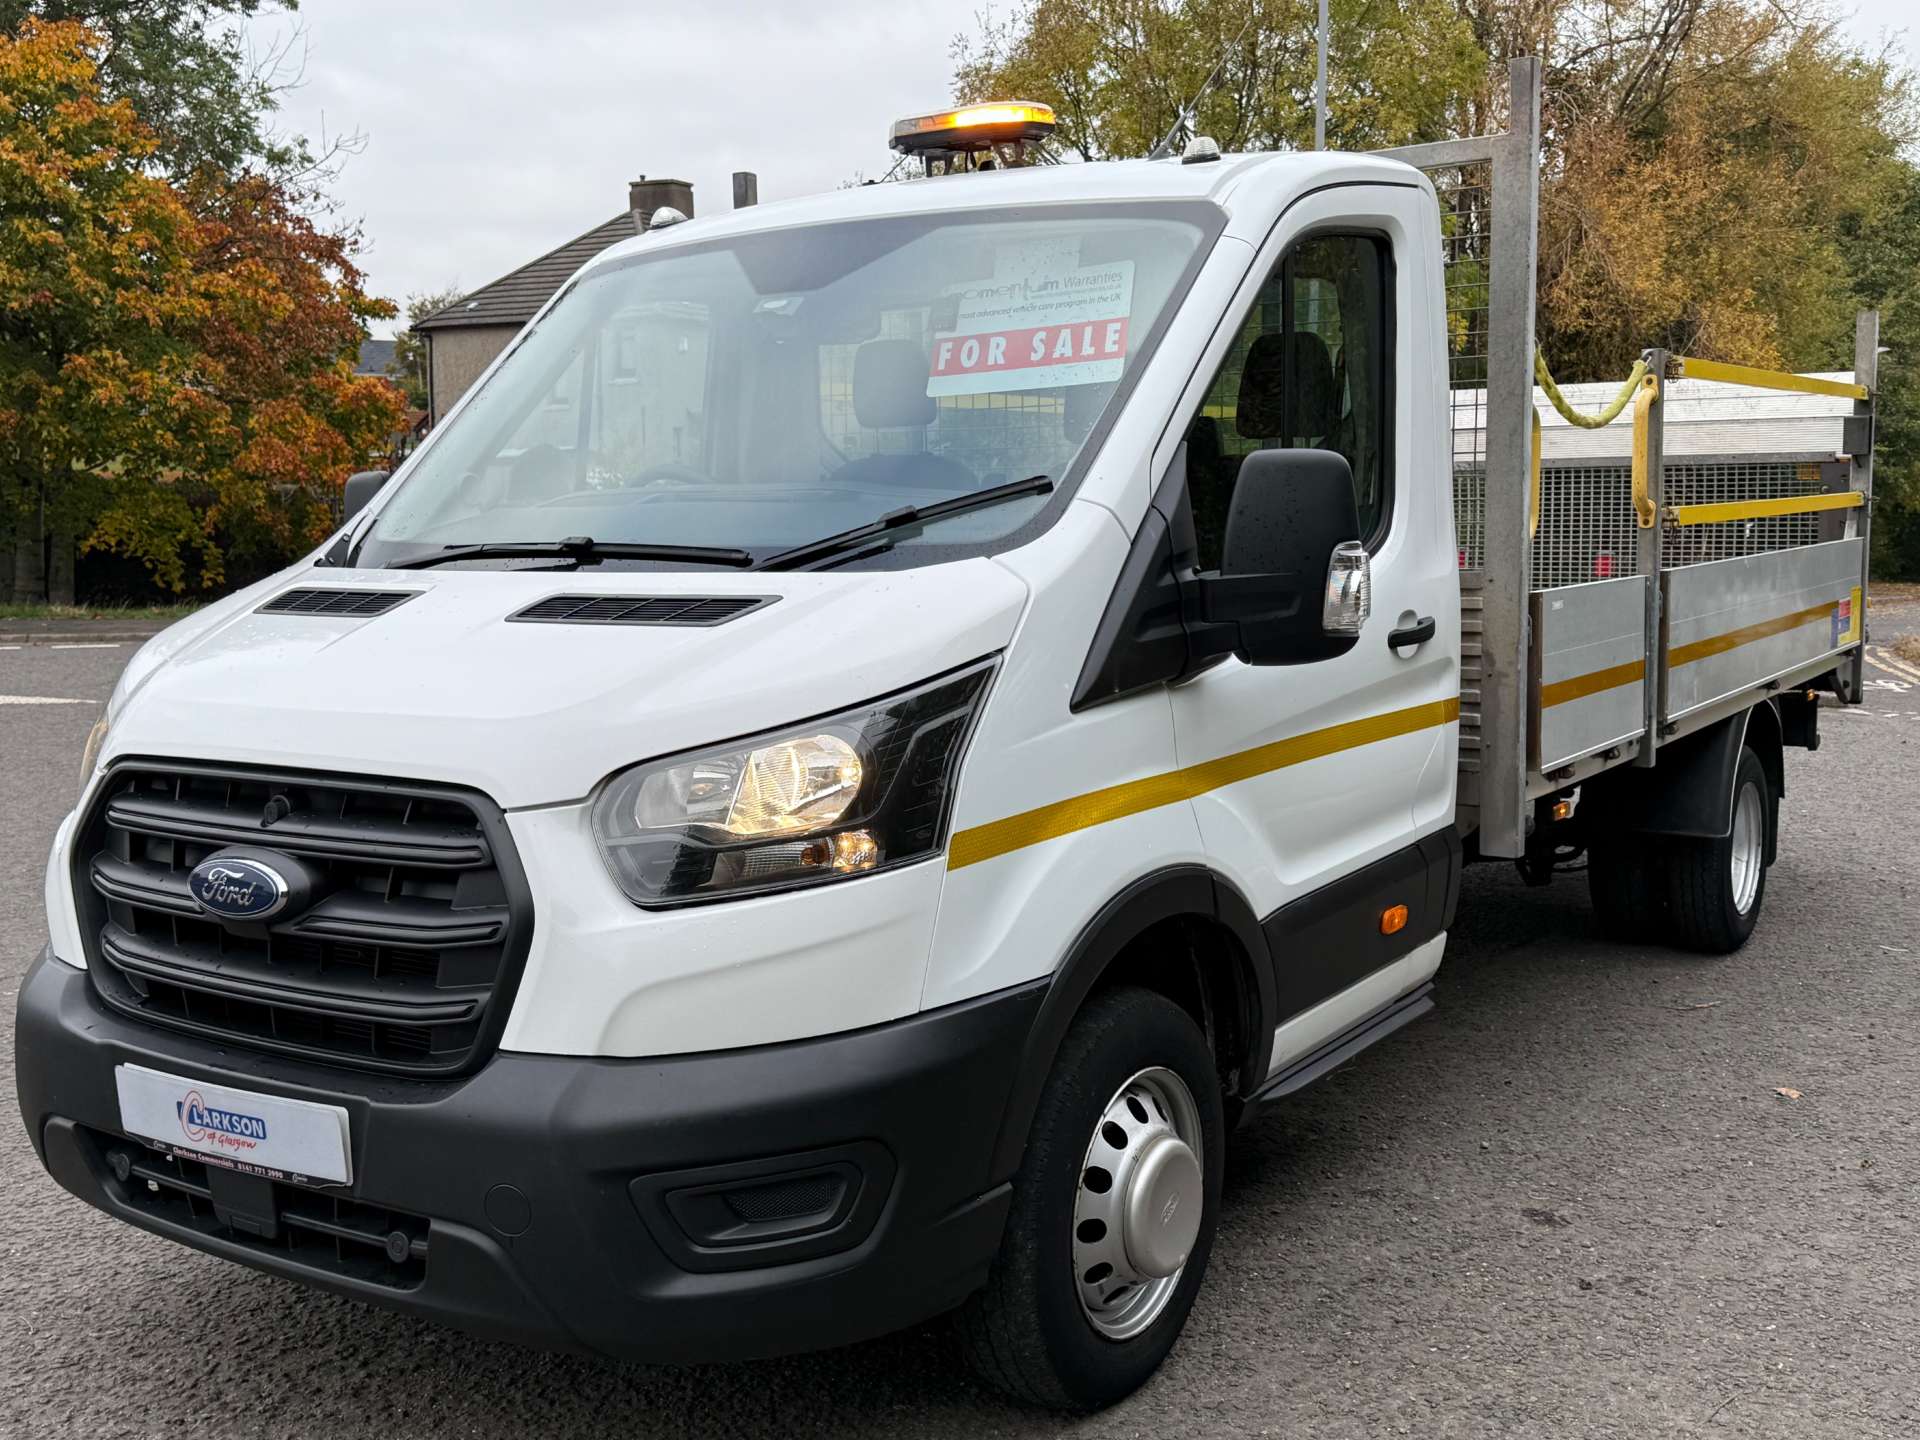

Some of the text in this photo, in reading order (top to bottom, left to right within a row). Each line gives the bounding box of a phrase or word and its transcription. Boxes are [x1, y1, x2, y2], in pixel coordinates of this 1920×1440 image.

[1064, 271, 1123, 288] Warranties
[937, 322, 1121, 370] FOR SALE
[201, 867, 257, 906] Ford
[181, 1090, 264, 1142] CLARKSON
[173, 1147, 196, 1159] Clarkson
[207, 1132, 256, 1151] of Glasgow
